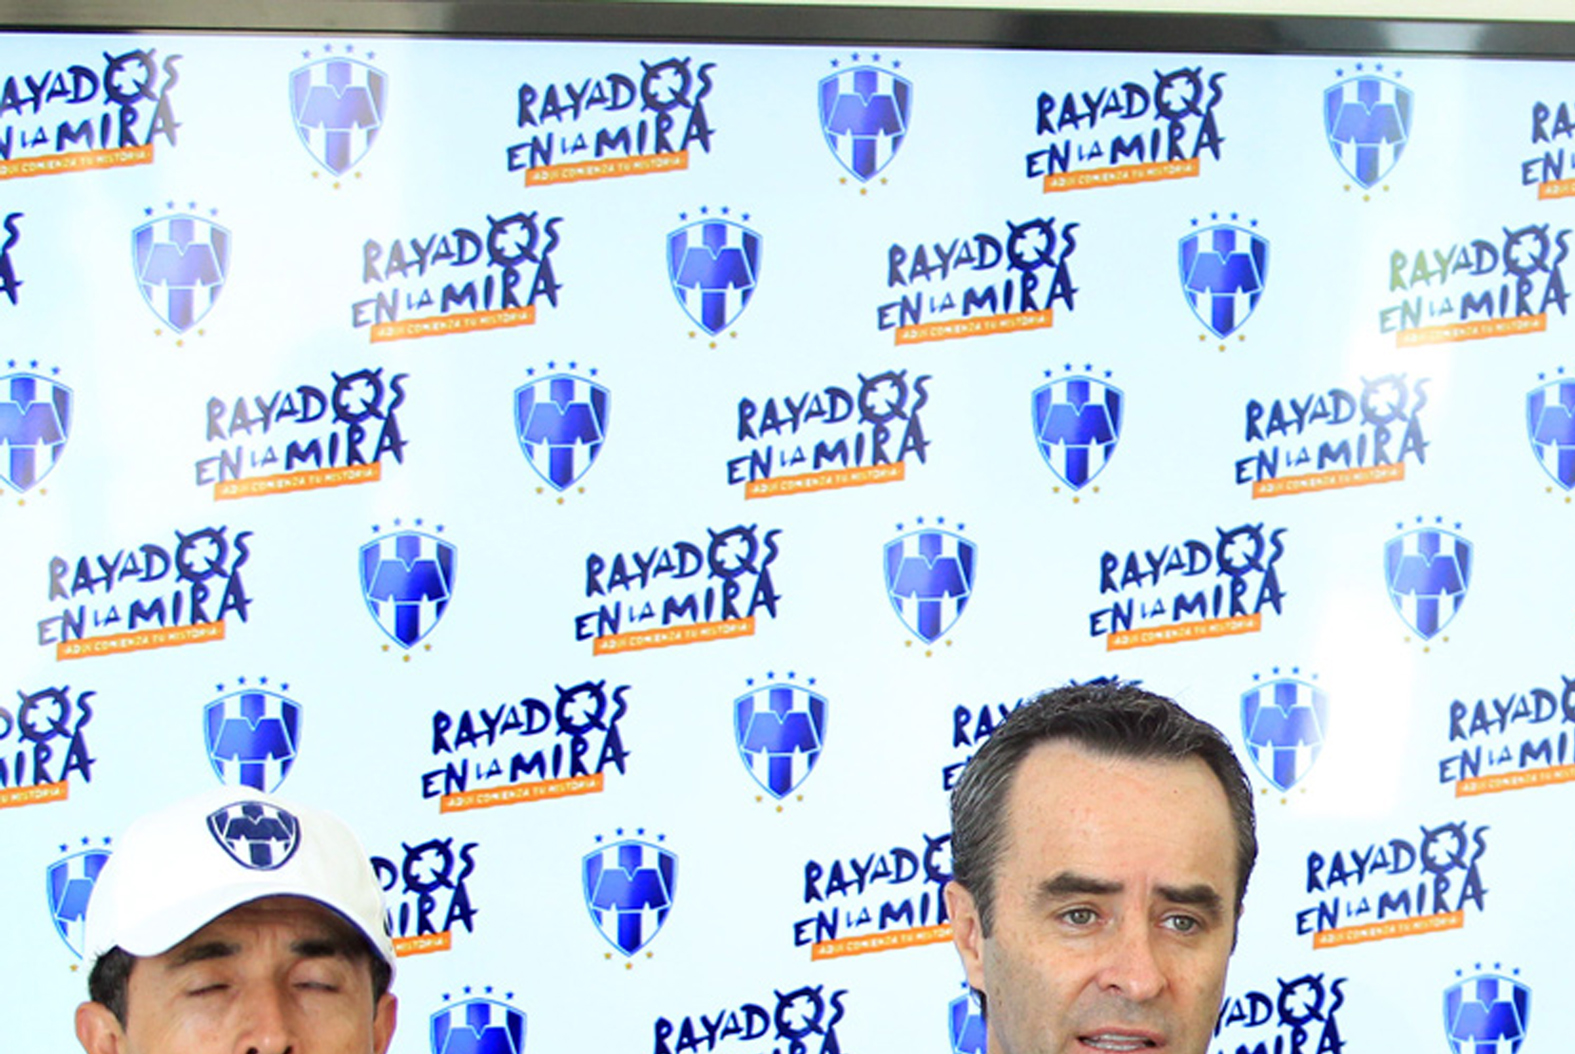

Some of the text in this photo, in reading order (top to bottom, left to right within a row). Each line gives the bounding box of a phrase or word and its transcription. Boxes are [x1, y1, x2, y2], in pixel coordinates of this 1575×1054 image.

[0, 47, 183, 118] AYADOS
[518, 57, 716, 127] RAYADOS
[1037, 67, 1225, 135] RAYADOS
[21, 91, 183, 152] LA MIRA
[507, 101, 716, 171] EN LA MIRA
[1026, 142, 1070, 178] EN
[1079, 142, 1102, 161] LA
[1111, 110, 1225, 164] MIRA
[1521, 150, 1562, 185] EN
[363, 211, 563, 282] RAYADOS
[889, 217, 1079, 287] RAYADOS
[1389, 224, 1571, 292] RAYADOS
[352, 289, 398, 326] EN
[408, 289, 433, 309] LA
[442, 255, 563, 311] MIRA
[878, 293, 922, 330] EN
[931, 293, 955, 313] LA
[963, 260, 1079, 315] MIRA
[1379, 298, 1421, 334] EN
[1429, 298, 1452, 317] LA
[1460, 265, 1571, 319] MIRA
[206, 367, 409, 440] RAYADOS
[738, 370, 931, 441] RAYADOS
[1246, 372, 1430, 442] RAYADOS
[195, 446, 242, 484] EN
[251, 446, 277, 466] LA
[286, 411, 409, 468] MIRA
[728, 447, 772, 484] EN
[781, 447, 806, 467] LA
[814, 413, 931, 469] MIRA
[1235, 448, 1277, 484] EN
[1286, 447, 1309, 467] LA
[1317, 414, 1429, 469] MIRA
[47, 524, 253, 599] RAYADOS
[587, 523, 782, 596] RAYADOS
[1100, 523, 1286, 594] RAYADOS
[36, 605, 83, 644] EN
[93, 605, 119, 625] LA
[128, 569, 253, 627] MIRA
[576, 567, 782, 640] EN LA MIRA
[1089, 599, 1132, 636] EN
[1141, 599, 1165, 619] LA
[1173, 565, 1286, 620] MIRA
[433, 679, 631, 754] RAYADOS
[422, 722, 631, 797] EN LA MIRA
[1438, 746, 1480, 783] EN
[1489, 746, 1511, 765] LA
[1306, 820, 1489, 892] RAYADOS
[794, 907, 838, 945] EN
[847, 907, 871, 927] LA
[1296, 897, 1338, 934] EN
[1347, 897, 1370, 916] LA
[1378, 862, 1488, 918] MIRA
